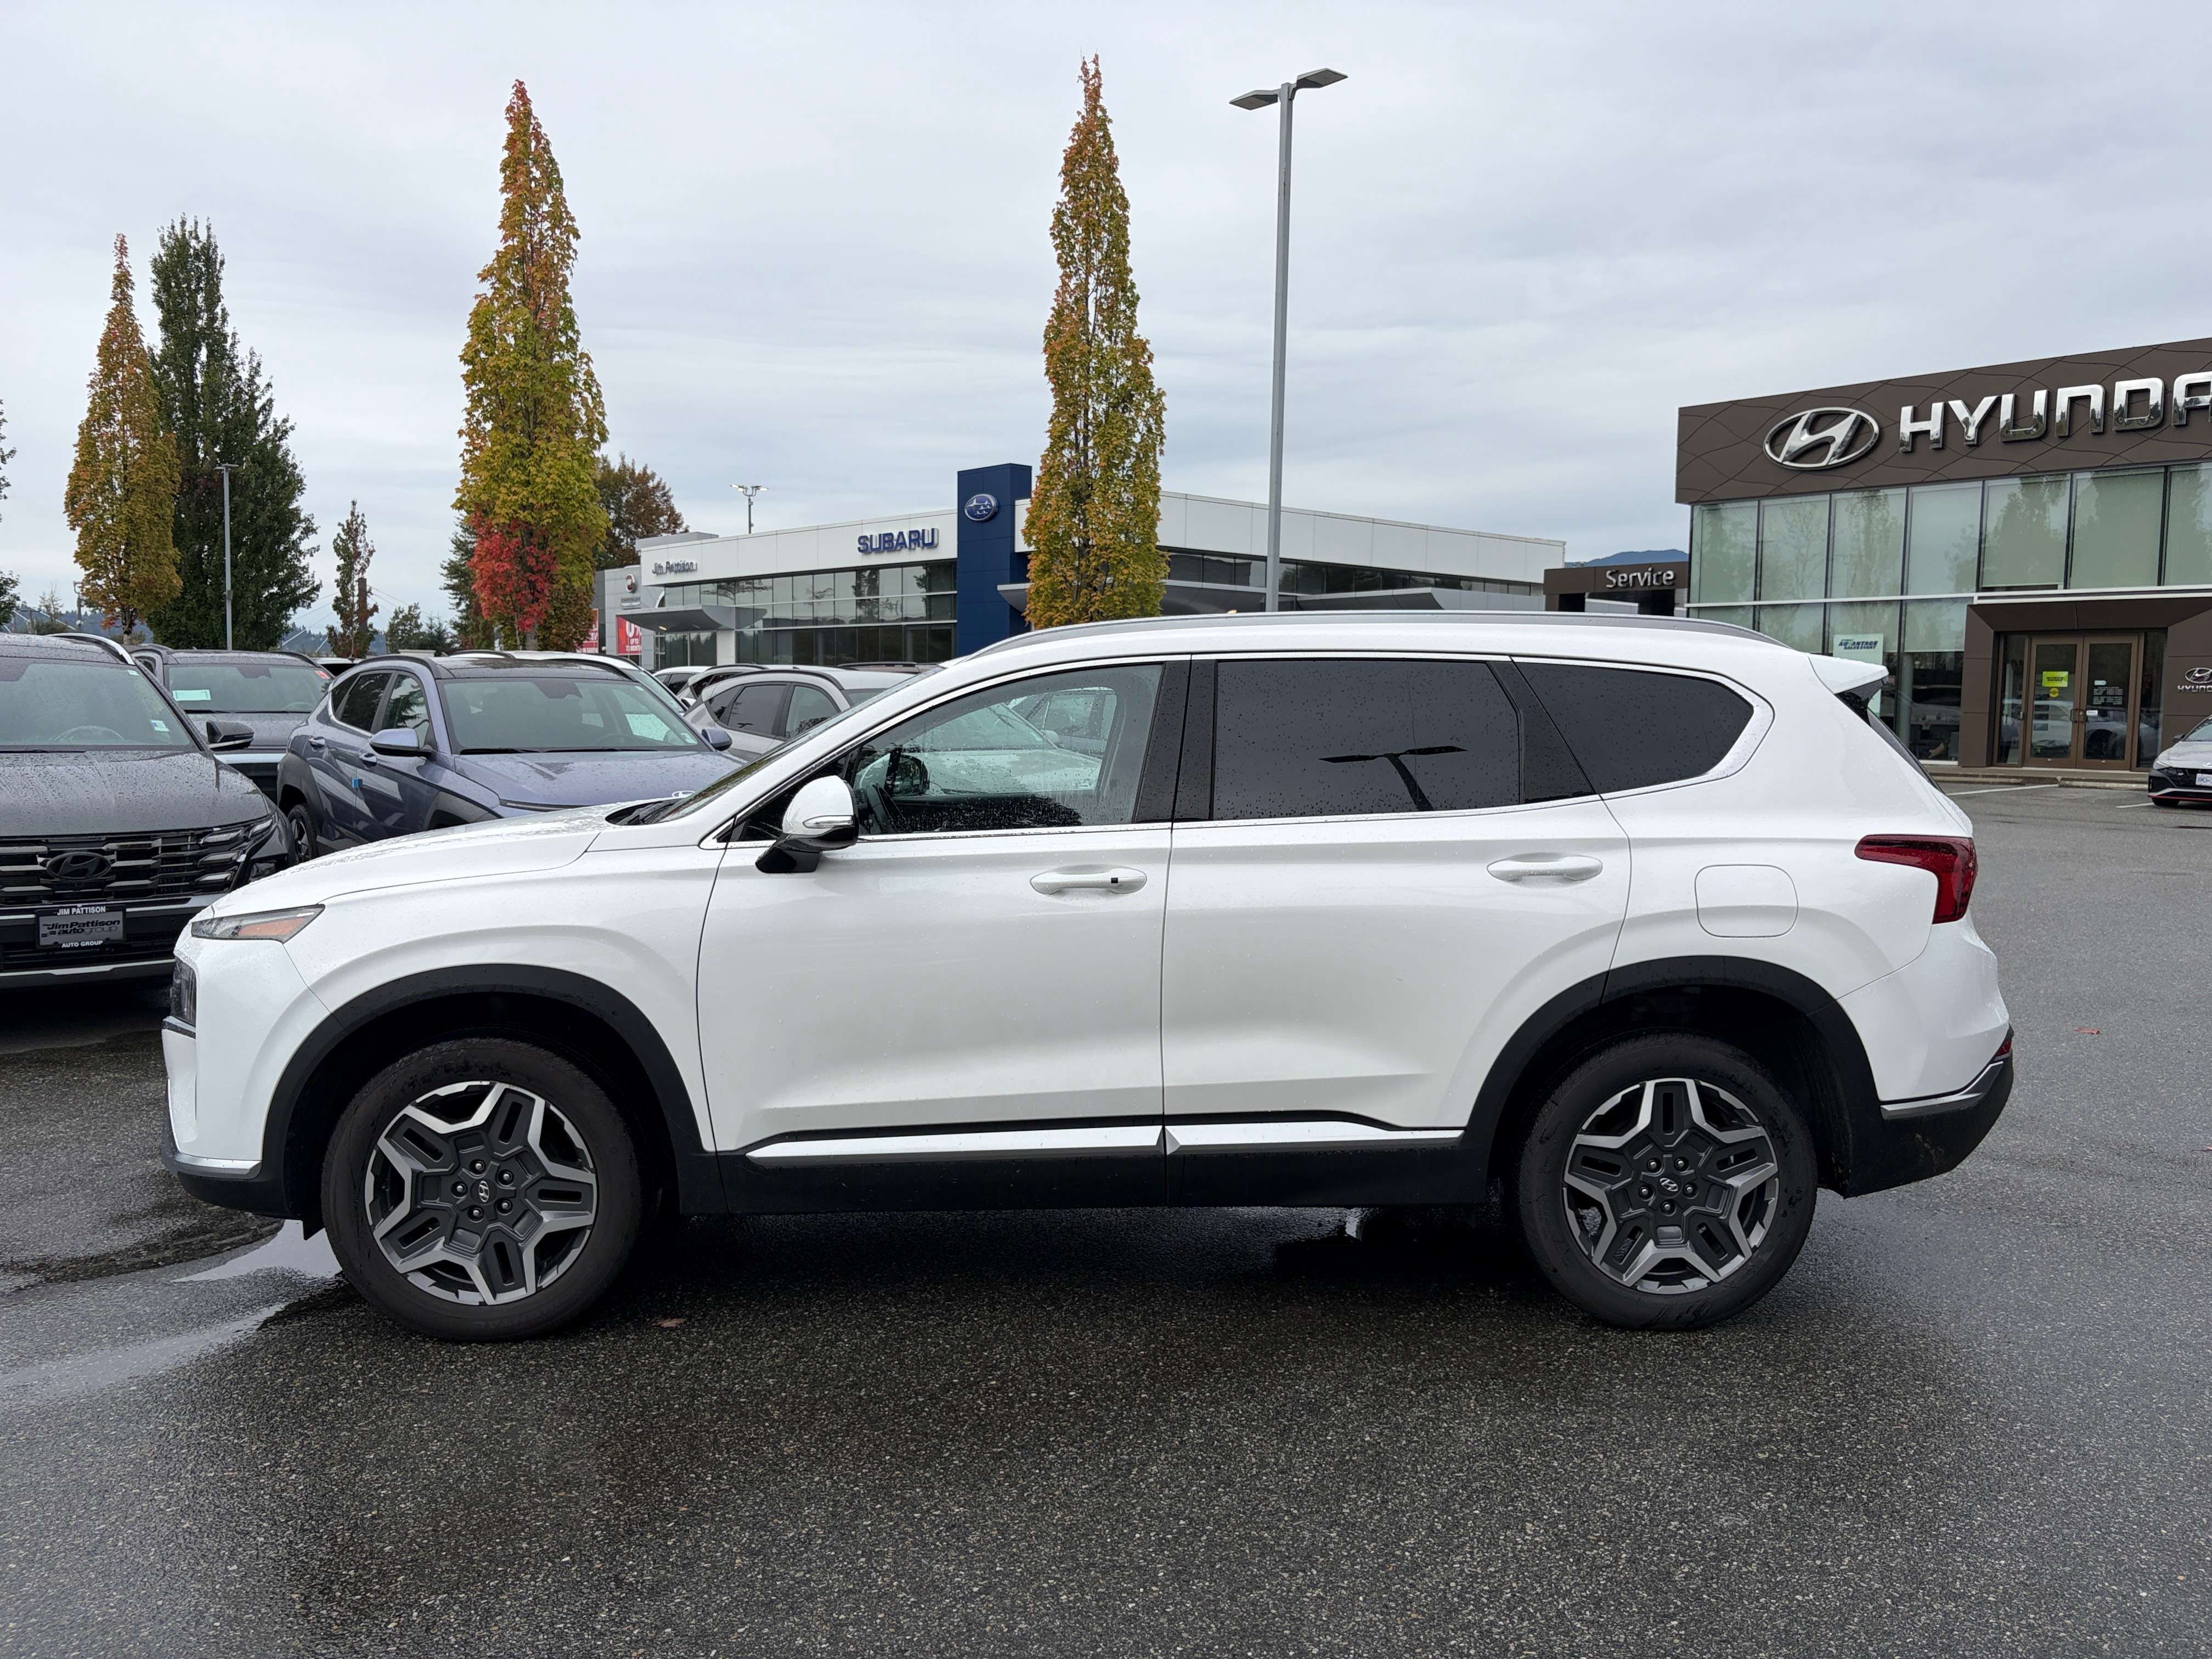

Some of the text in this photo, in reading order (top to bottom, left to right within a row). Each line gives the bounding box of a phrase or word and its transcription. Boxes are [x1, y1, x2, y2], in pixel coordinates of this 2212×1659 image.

[857, 528, 939, 554] SUBARU
[652, 561, 665, 574] Jim
[1605, 566, 1674, 588] Service
[71, 906, 106, 915] PATTISON
[69, 919, 120, 929] Pattison
